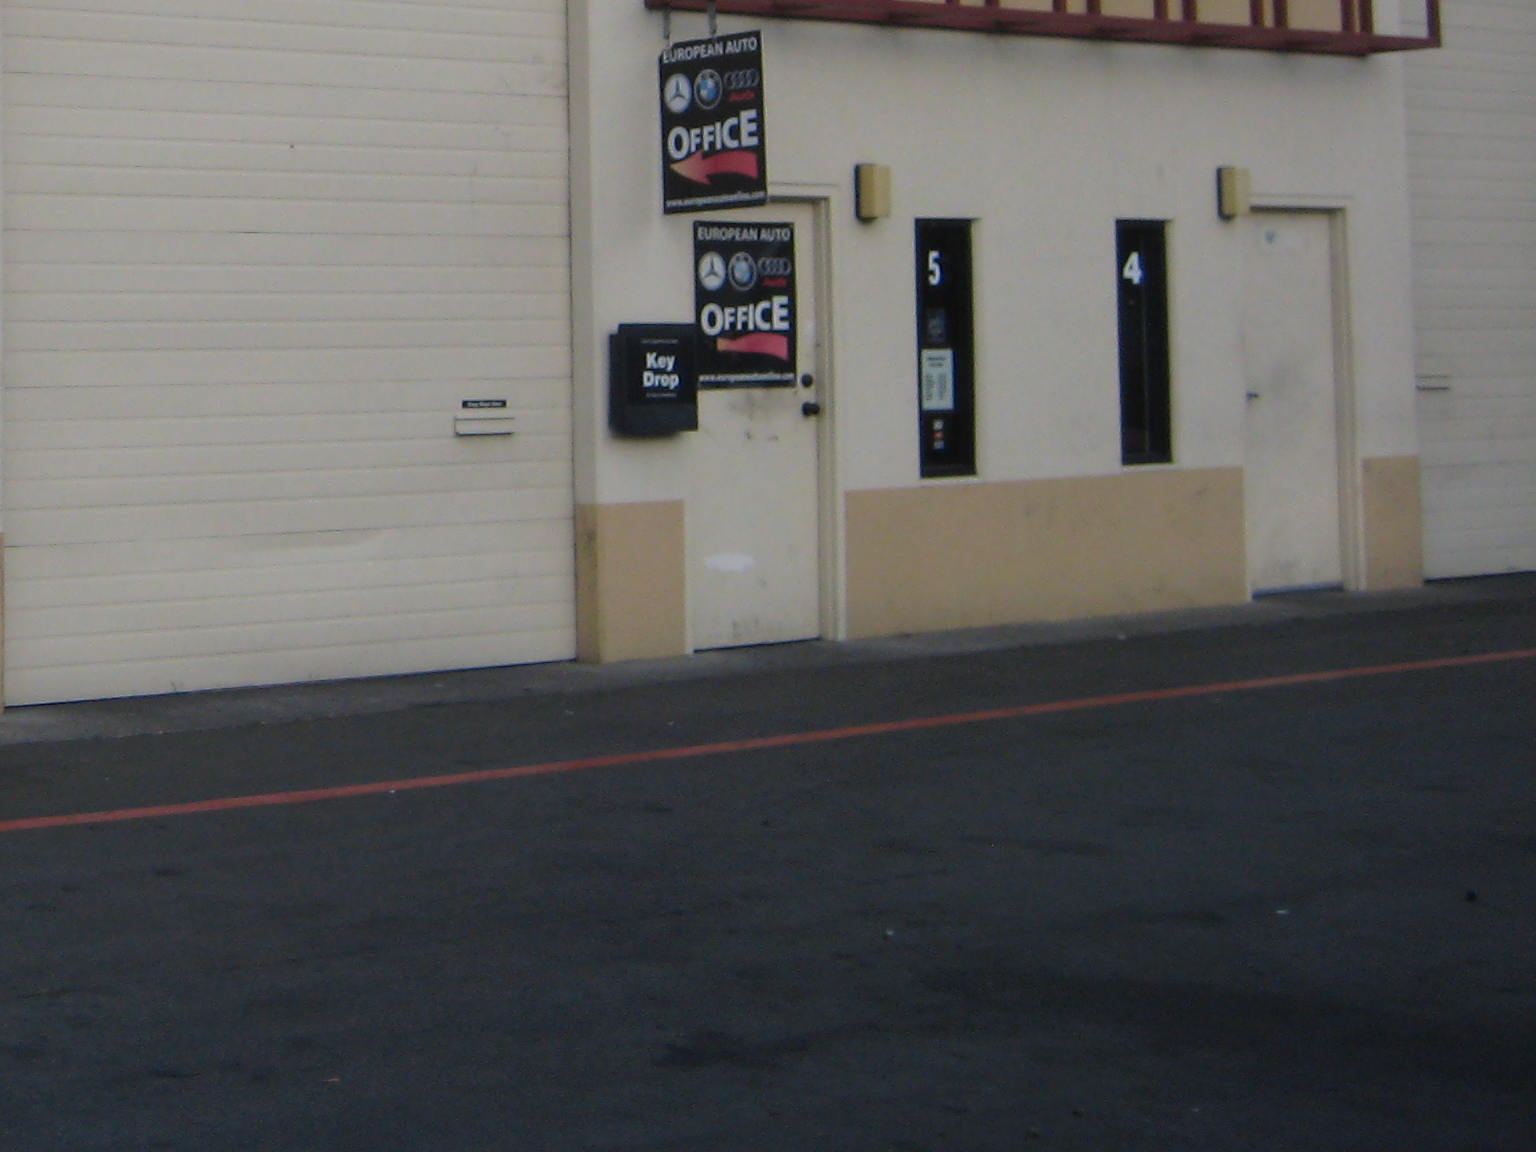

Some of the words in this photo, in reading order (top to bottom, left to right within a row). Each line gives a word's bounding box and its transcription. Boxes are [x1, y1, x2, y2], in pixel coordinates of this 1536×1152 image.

[663, 42, 724, 64] EUROPEAN
[724, 36, 758, 56] AUTO
[668, 110, 759, 160] OFFICE
[697, 226, 758, 242] EUROPEAN
[760, 226, 791, 241] AUTO
[927, 251, 941, 285] 5
[1123, 252, 1141, 284] 4
[700, 295, 790, 335] OFFICE
[646, 352, 675, 371] Key
[643, 371, 679, 389] Drop
